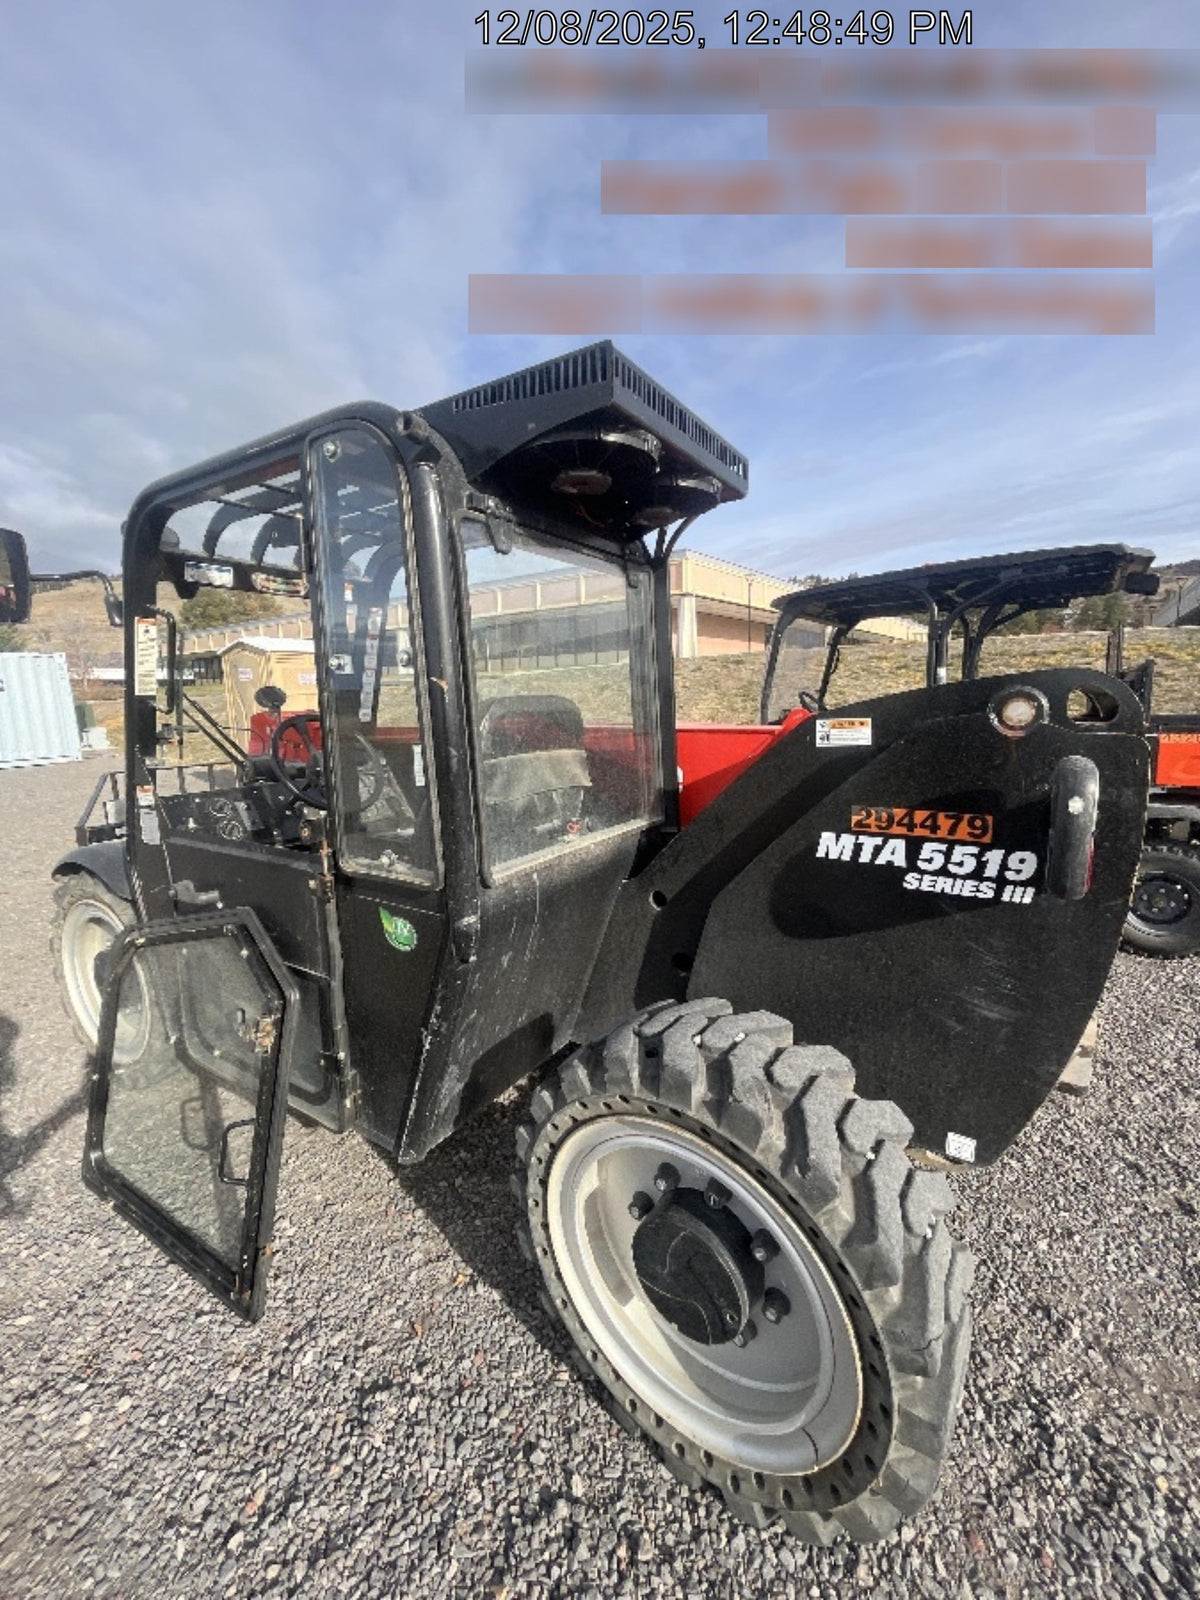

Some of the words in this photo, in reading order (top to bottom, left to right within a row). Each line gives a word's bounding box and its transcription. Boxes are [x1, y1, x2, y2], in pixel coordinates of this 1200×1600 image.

[852, 807, 991, 839] 294479
[815, 832, 907, 868] MTA
[917, 842, 1038, 881] 5519
[903, 872, 996, 898] SERIES
[1000, 885, 1035, 904] III
